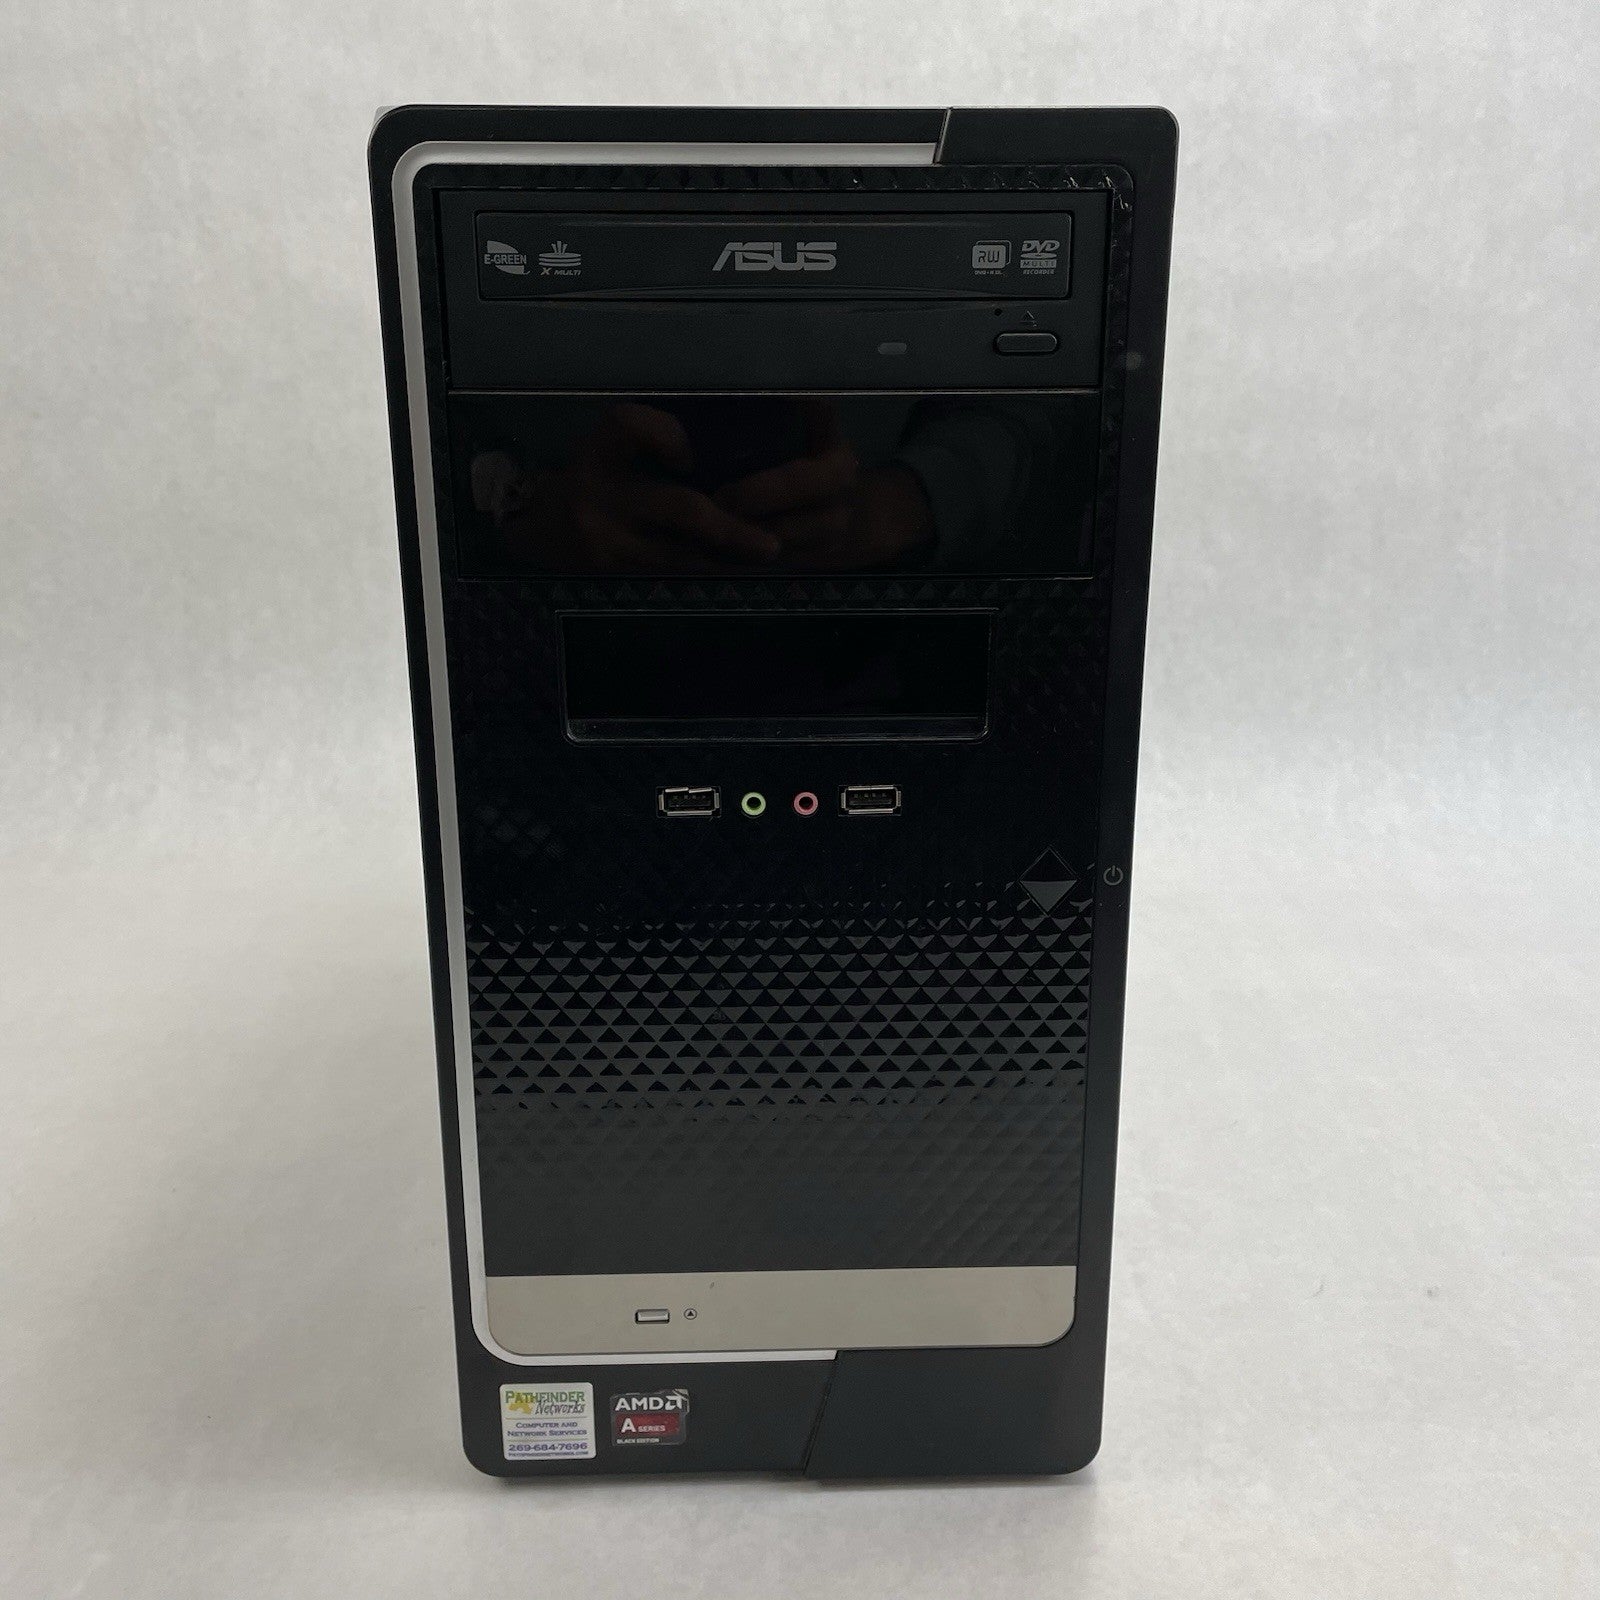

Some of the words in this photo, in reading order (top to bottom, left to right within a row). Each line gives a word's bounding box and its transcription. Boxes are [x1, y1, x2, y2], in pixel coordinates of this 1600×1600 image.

[1022, 240, 1060, 254] DVD
[483, 254, 527, 265] E-GREEN
[712, 241, 837, 271] ASUS
[978, 250, 1000, 263] RW
[505, 1390, 585, 1404] PATHFINDER
[614, 1397, 664, 1411] AMD
[534, 1400, 586, 1415] Networks
[621, 1418, 636, 1433] A
[638, 1425, 666, 1433] SERIES
[508, 1442, 588, 1452] 269-684-7696
